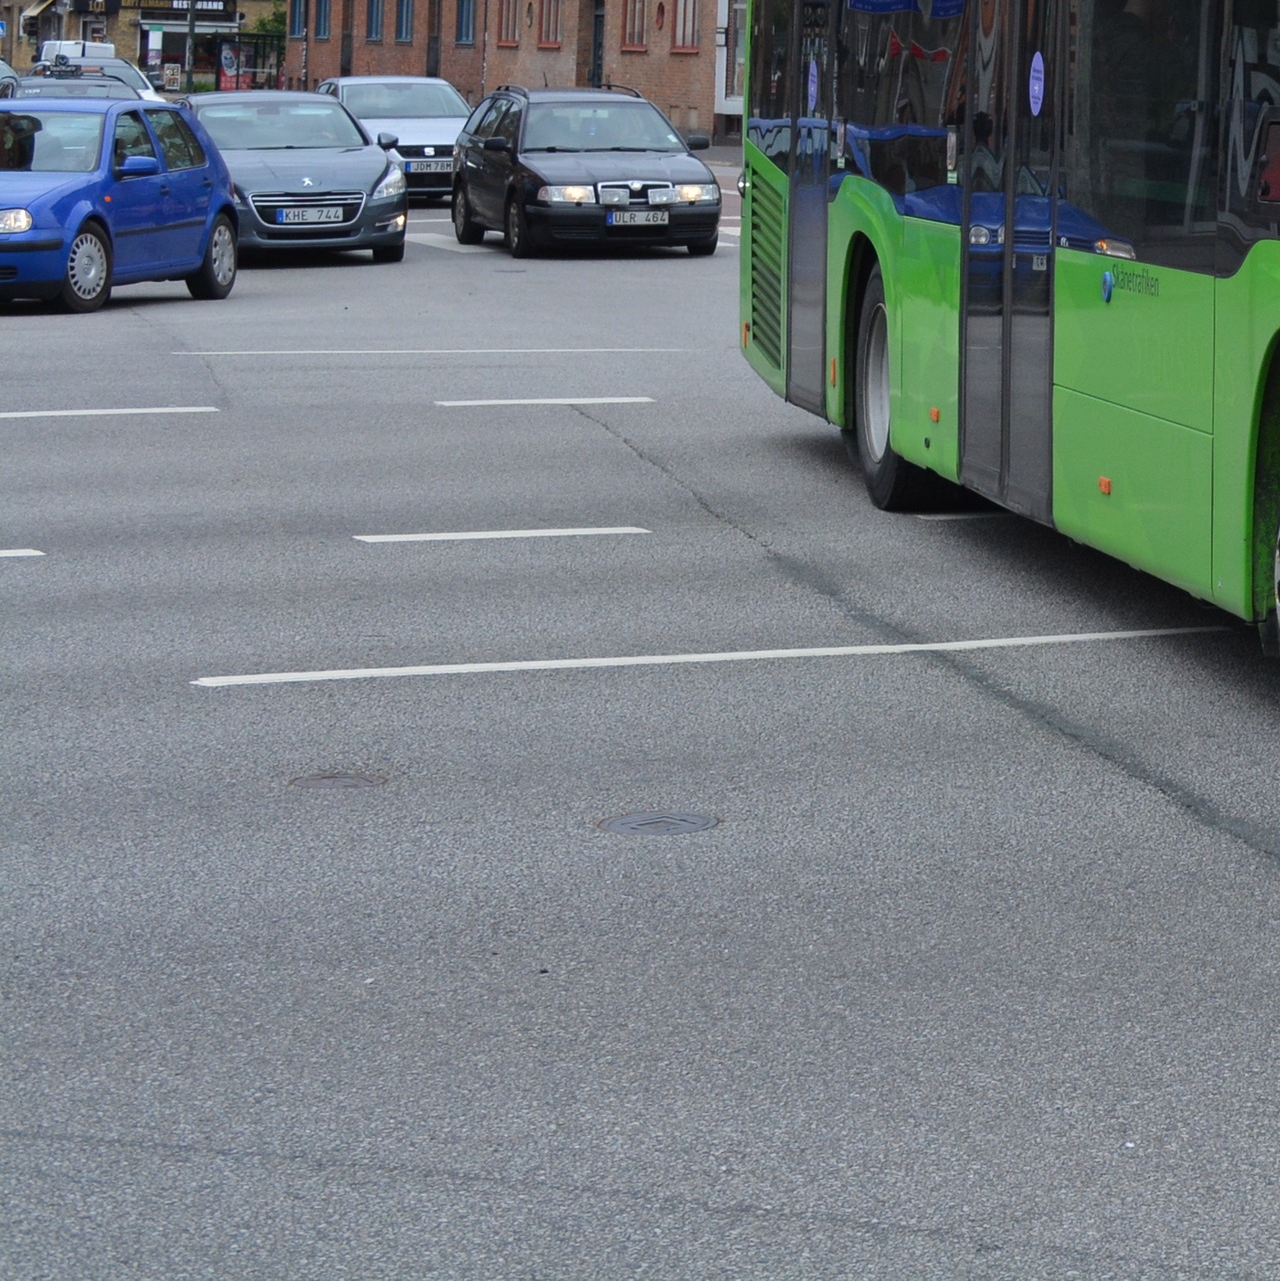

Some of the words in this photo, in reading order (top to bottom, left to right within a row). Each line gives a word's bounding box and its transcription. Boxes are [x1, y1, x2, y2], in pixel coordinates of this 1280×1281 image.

[172, 0, 224, 10] RESTURANG
[284, 209, 308, 221] KHE
[317, 208, 341, 220] 744
[614, 212, 637, 224] ULR
[644, 212, 667, 223] 464
[1112, 262, 1160, 297] Skånetrafiken
